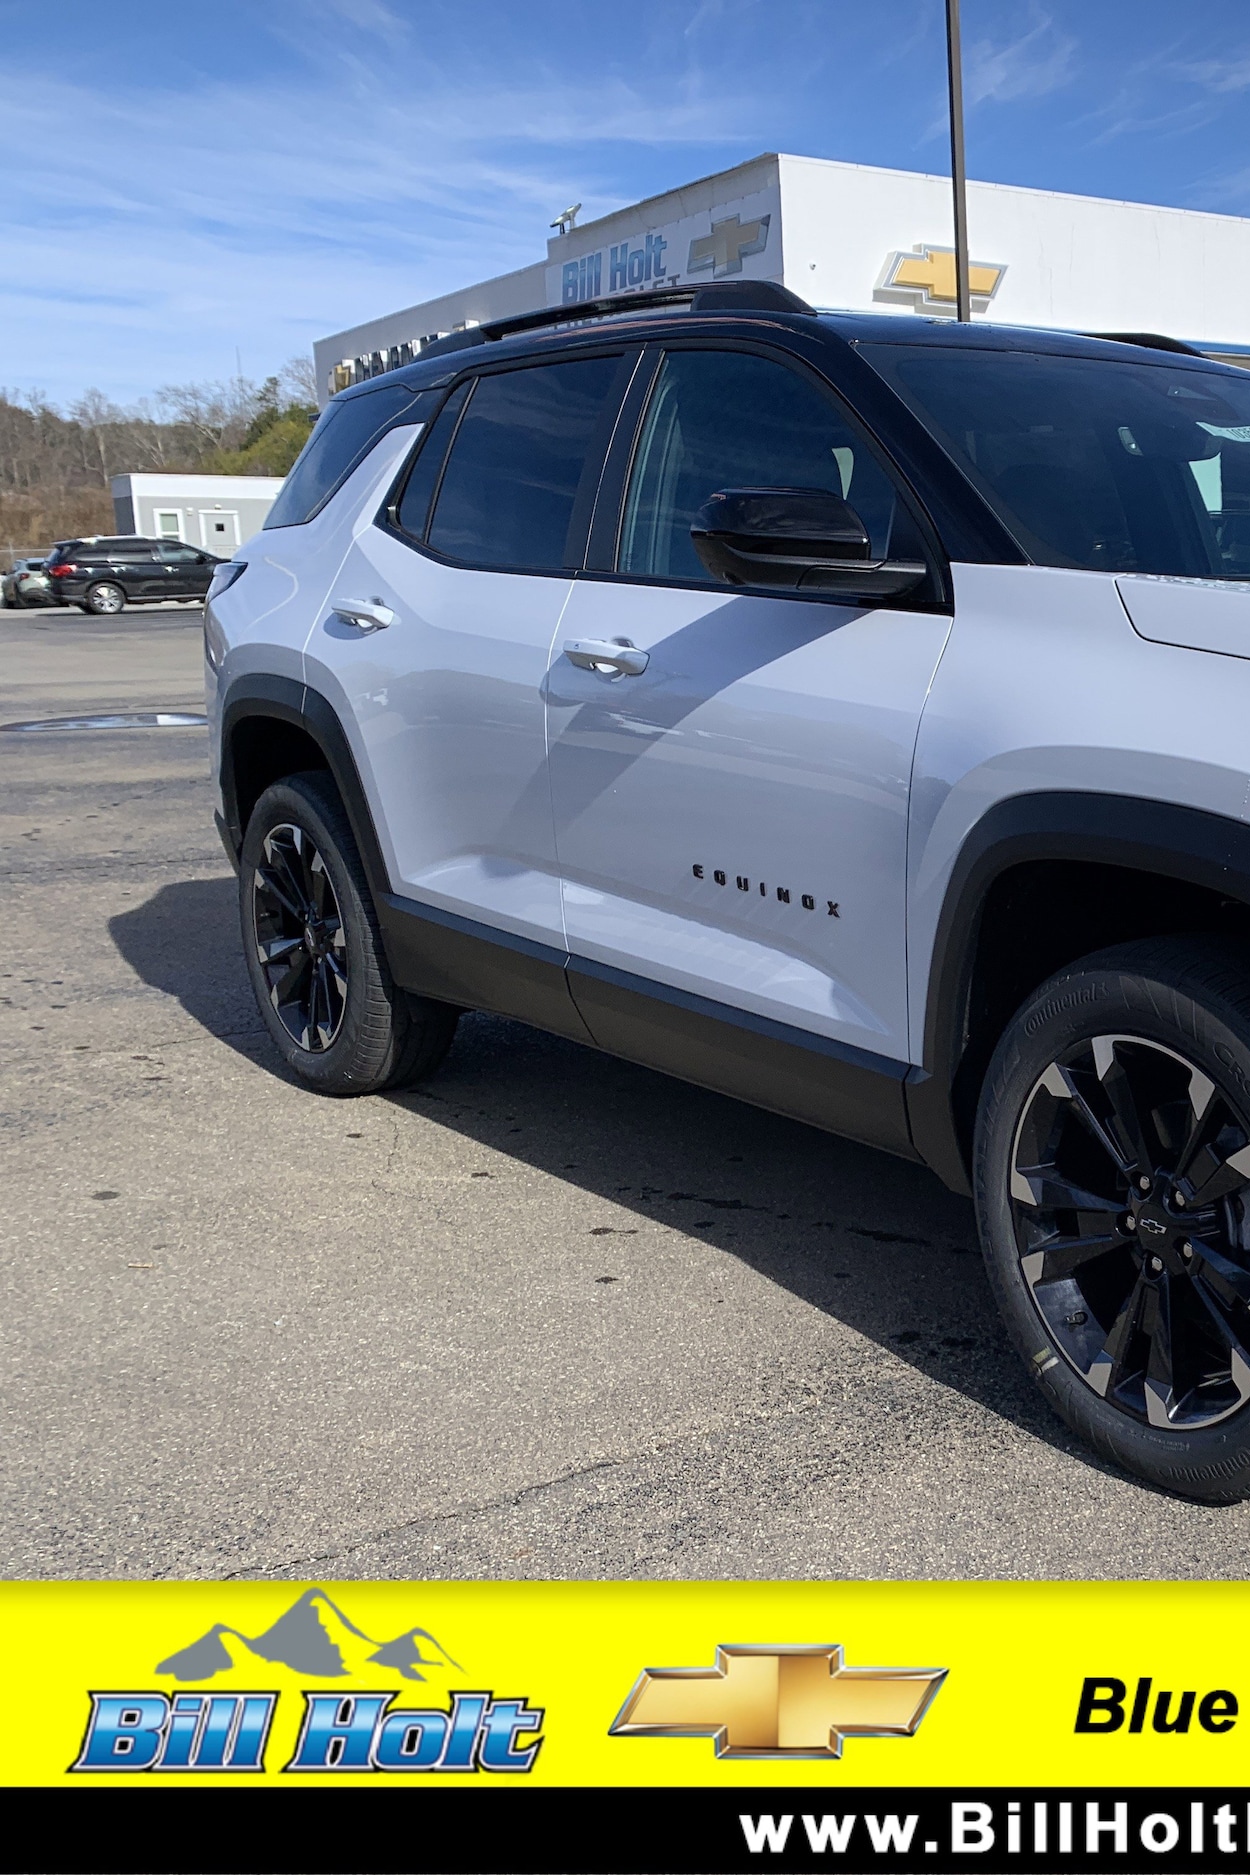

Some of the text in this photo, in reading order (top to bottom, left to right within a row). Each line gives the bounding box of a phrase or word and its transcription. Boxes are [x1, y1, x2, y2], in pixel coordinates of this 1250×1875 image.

[562, 251, 602, 304] Bill
[609, 234, 668, 292] Holt
[692, 864, 841, 918] EQUINOX
[1024, 982, 1098, 1037] Continental
